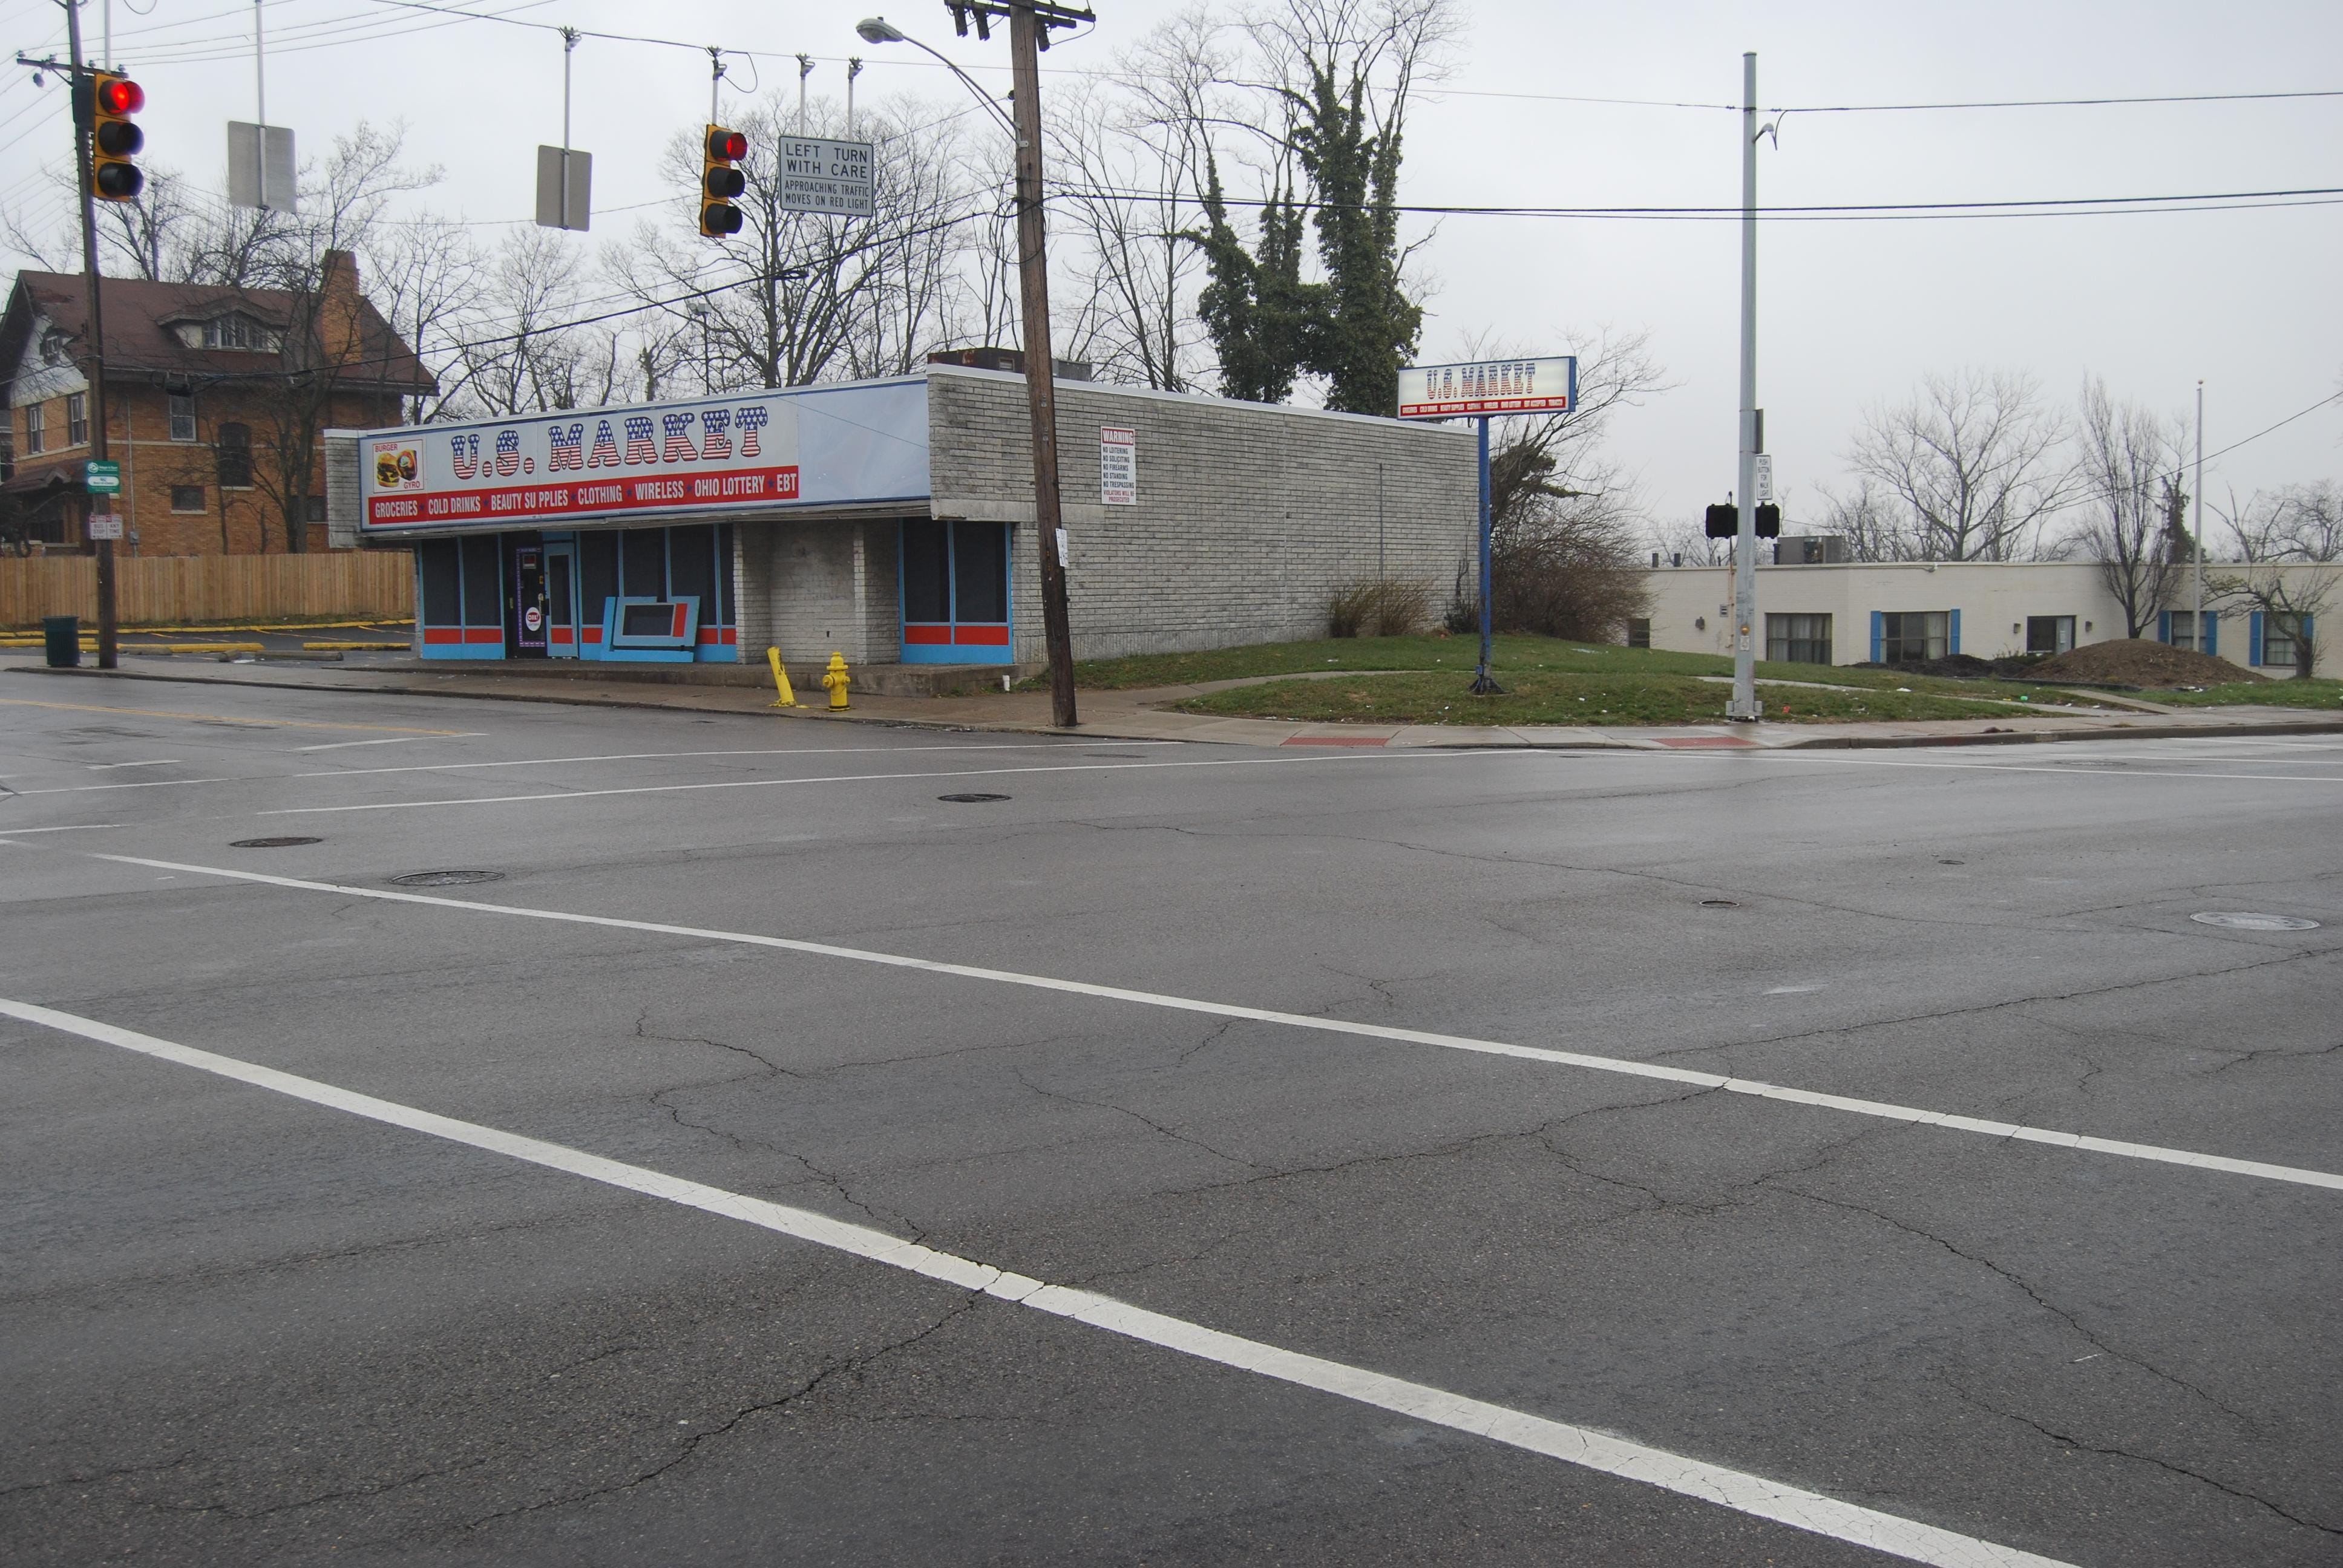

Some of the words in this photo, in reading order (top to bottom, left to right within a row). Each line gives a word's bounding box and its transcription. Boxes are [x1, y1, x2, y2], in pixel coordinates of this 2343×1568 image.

[786, 143, 820, 158] LEFT
[834, 148, 867, 163] TURN
[787, 159, 821, 174] WITH
[831, 163, 867, 178] CARE
[785, 180, 837, 194] APPROACHING
[841, 185, 869, 197] TRAFFIC
[785, 193, 811, 205] MOVES
[815, 195, 825, 206] ON
[830, 196, 844, 207] RED
[848, 198, 868, 209] LIGHT
[1427, 368, 1457, 399] U.S.
[1461, 363, 1535, 397] MARKET
[451, 430, 534, 480] U.S.
[548, 406, 768, 471] MARKET
[1103, 430, 1133, 444] WARNING
[375, 444, 398, 452] BURGER
[375, 500, 418, 518] GROCERIES
[428, 498, 448, 515] COLD
[451, 496, 480, 513] DRINKS
[491, 493, 522, 511] BEAUTY
[578, 484, 623, 505] CLOTHING
[635, 480, 684, 501] WIRELESS
[695, 478, 719, 497] OHIO
[723, 475, 765, 494] LOTTERY
[776, 473, 797, 492] EBT
